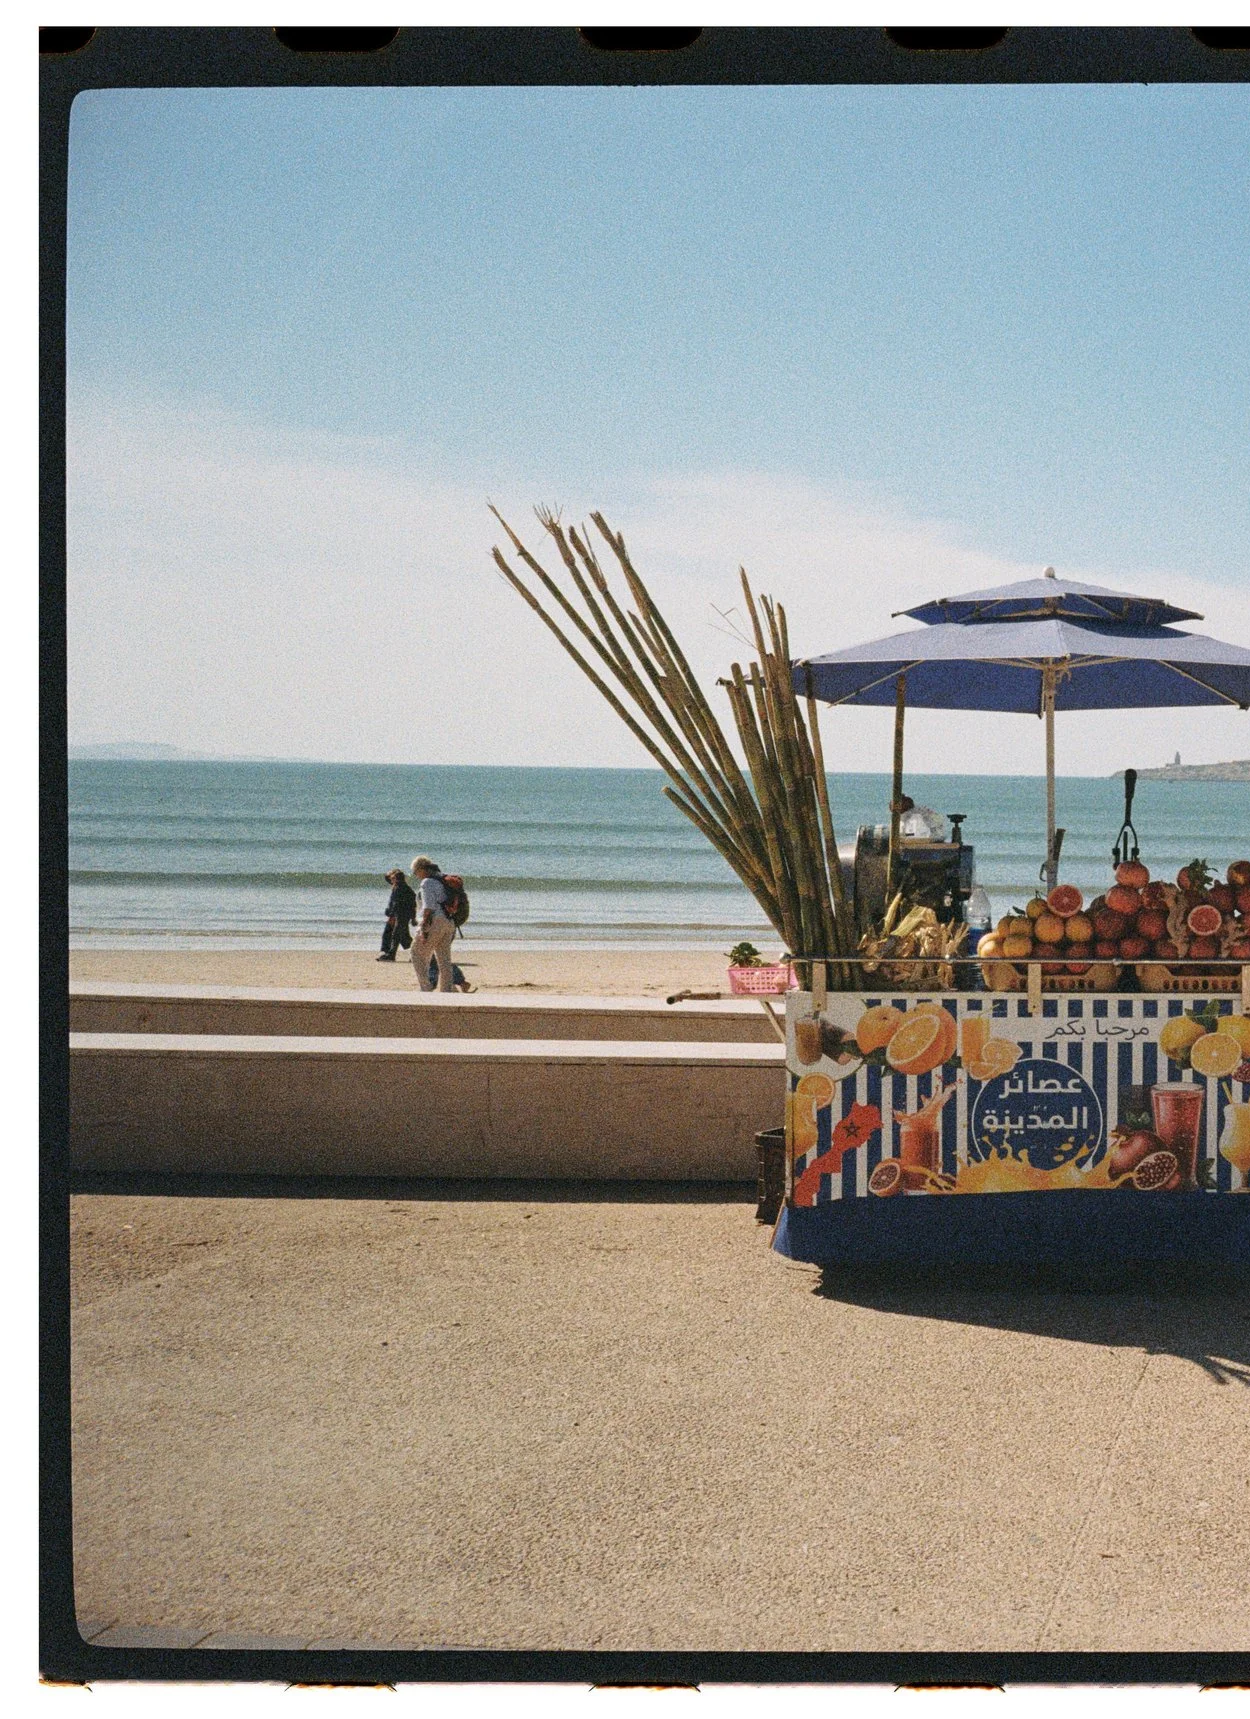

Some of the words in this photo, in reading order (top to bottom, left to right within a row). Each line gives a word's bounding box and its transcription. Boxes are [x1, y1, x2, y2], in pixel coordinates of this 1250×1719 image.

[1045, 1019, 1086, 1041] بكم
[1096, 1019, 1150, 1041] مرحبا
[998, 1070, 1082, 1099] عصائر
[982, 1106, 1088, 1134] المدينة
